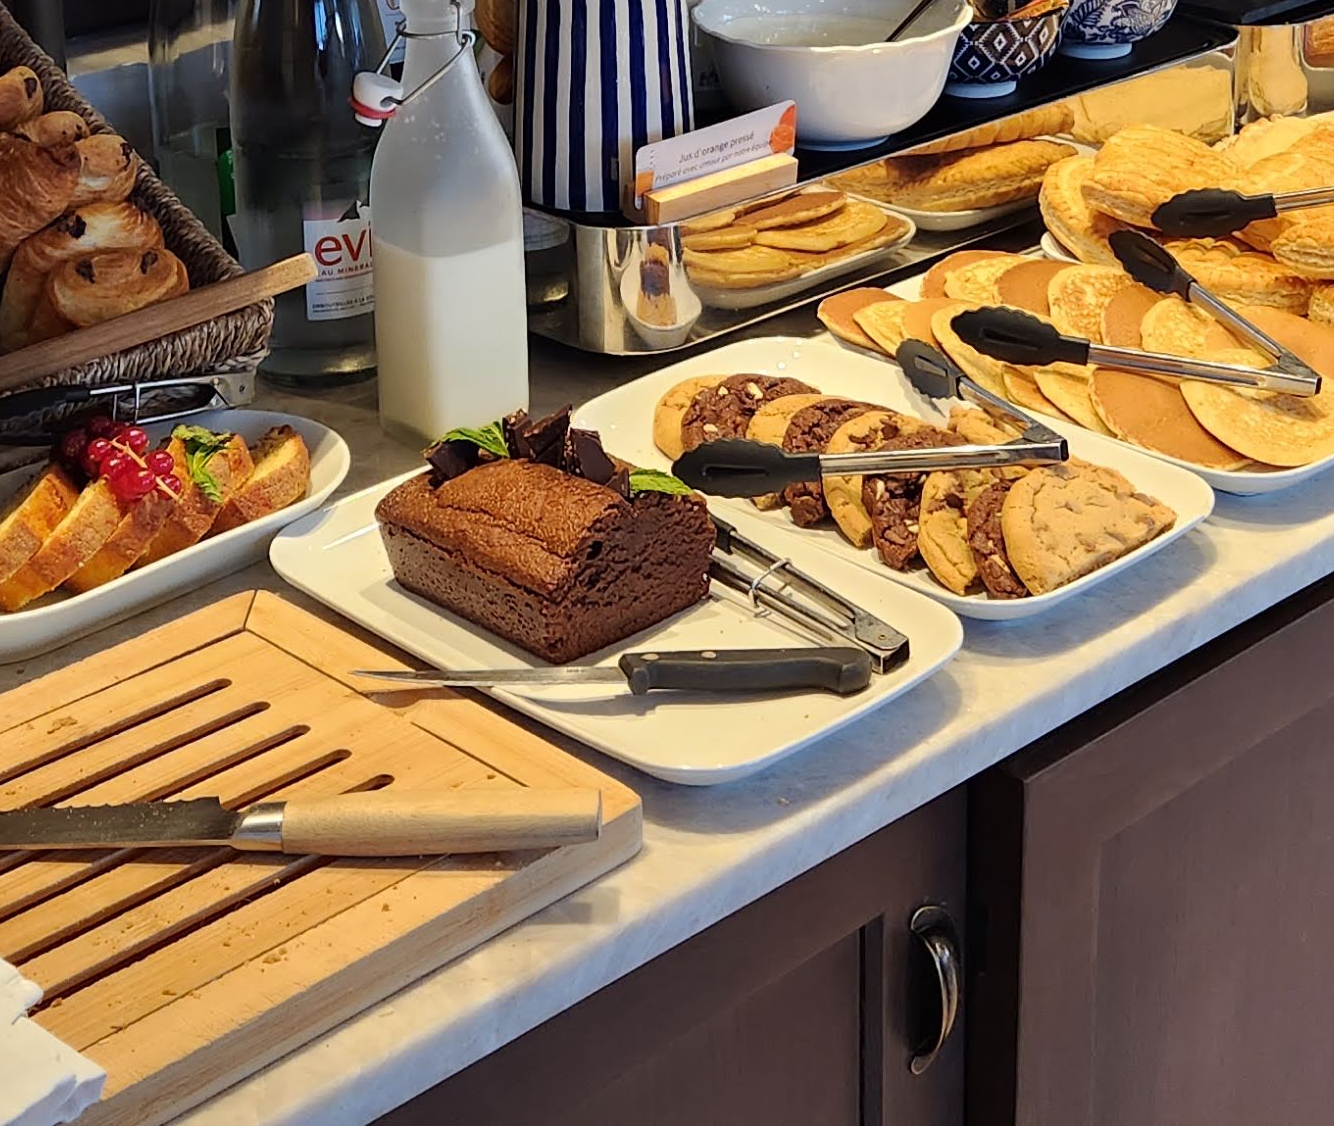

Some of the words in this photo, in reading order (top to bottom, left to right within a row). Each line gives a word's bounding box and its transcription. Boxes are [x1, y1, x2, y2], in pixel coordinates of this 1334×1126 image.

[678, 152, 693, 163] Jus
[694, 139, 729, 159] d'orange
[729, 131, 755, 150] pressé
[681, 164, 698, 176] avec
[721, 153, 733, 163] par
[314, 221, 372, 267] evi
[318, 268, 334, 276] AU
